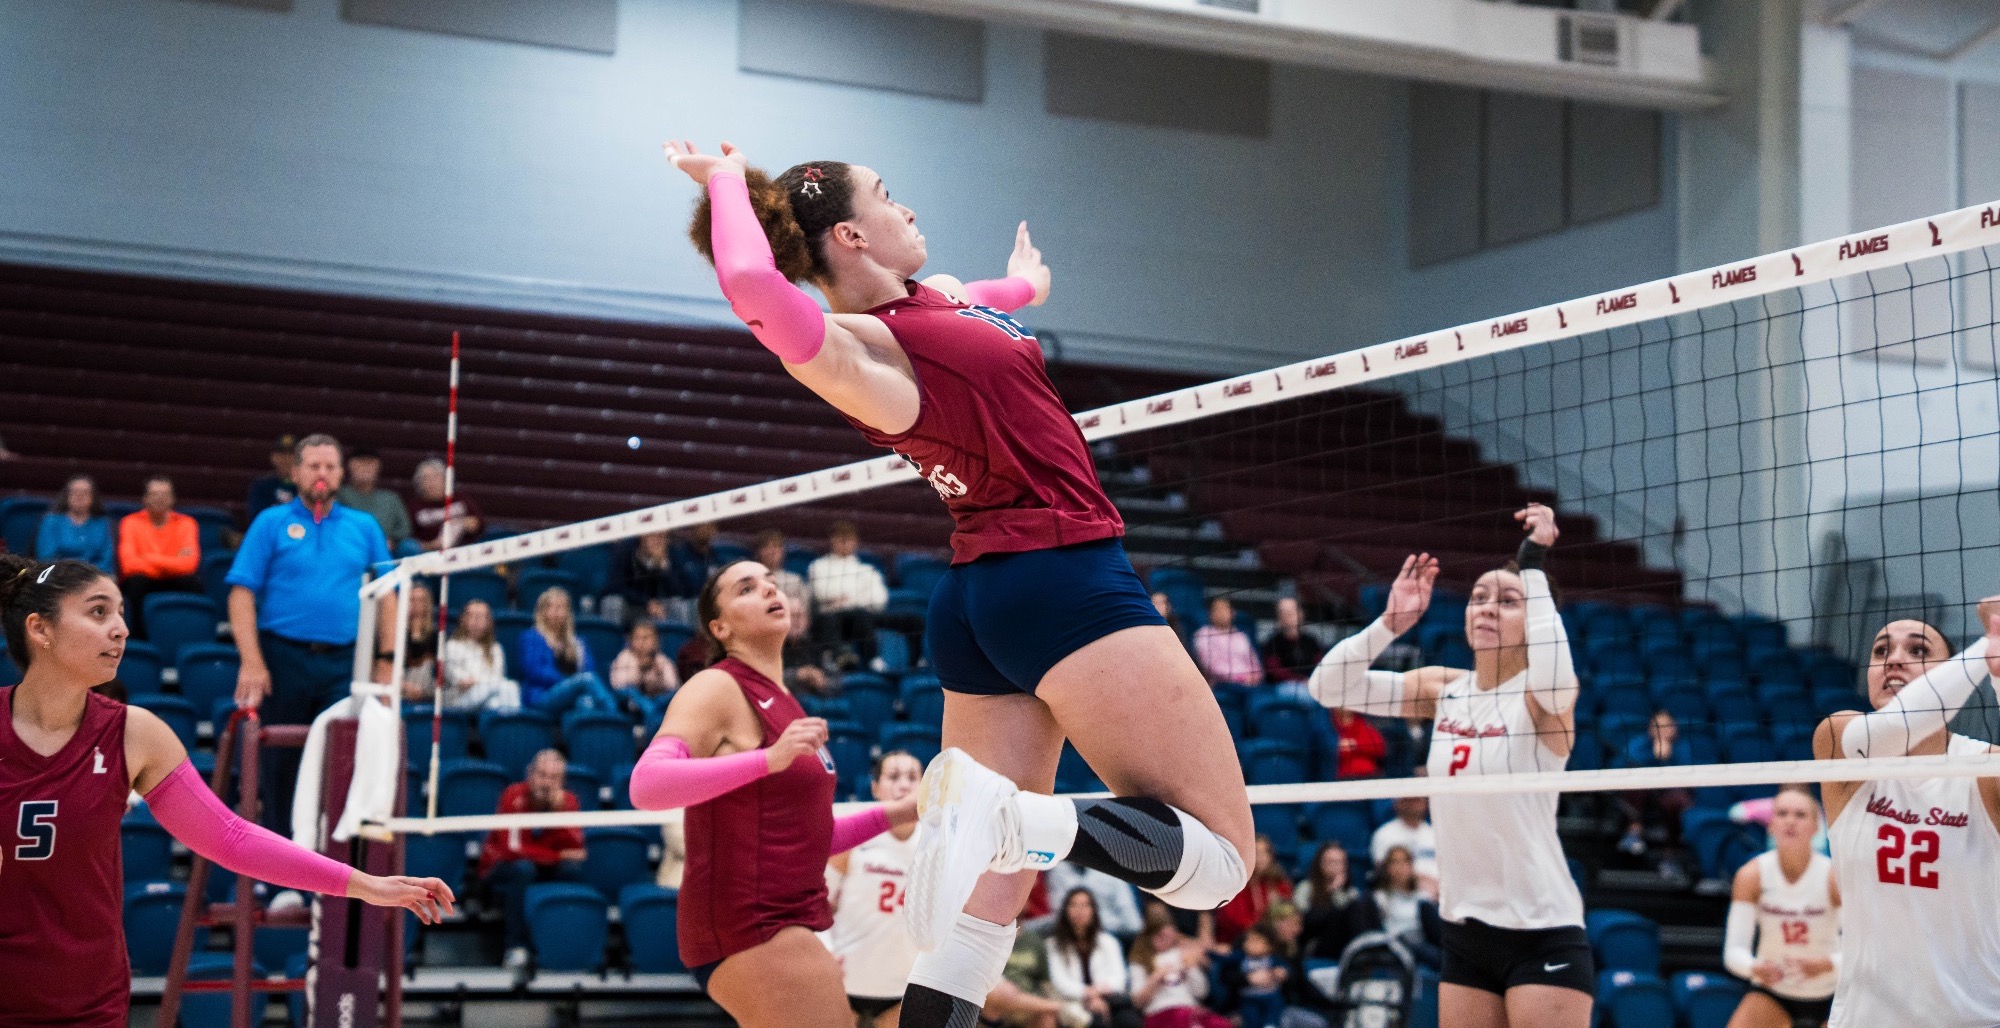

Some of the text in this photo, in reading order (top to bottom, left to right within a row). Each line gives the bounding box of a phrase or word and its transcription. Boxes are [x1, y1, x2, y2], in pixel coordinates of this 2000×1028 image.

[1223, 381, 1252, 397] FLAMES
[1304, 361, 1337, 380] FLAMES
[1394, 340, 1428, 360] FLAMES
[1491, 317, 1528, 338] FLAMES
[1596, 292, 1637, 315] FLAMES
[1712, 265, 1756, 289] FLAMES
[1839, 234, 1889, 260] FLAMES
[1448, 744, 1471, 776] 2
[15, 800, 59, 860] 5
[1876, 823, 1940, 889] 22
[1781, 921, 1808, 945] 12
